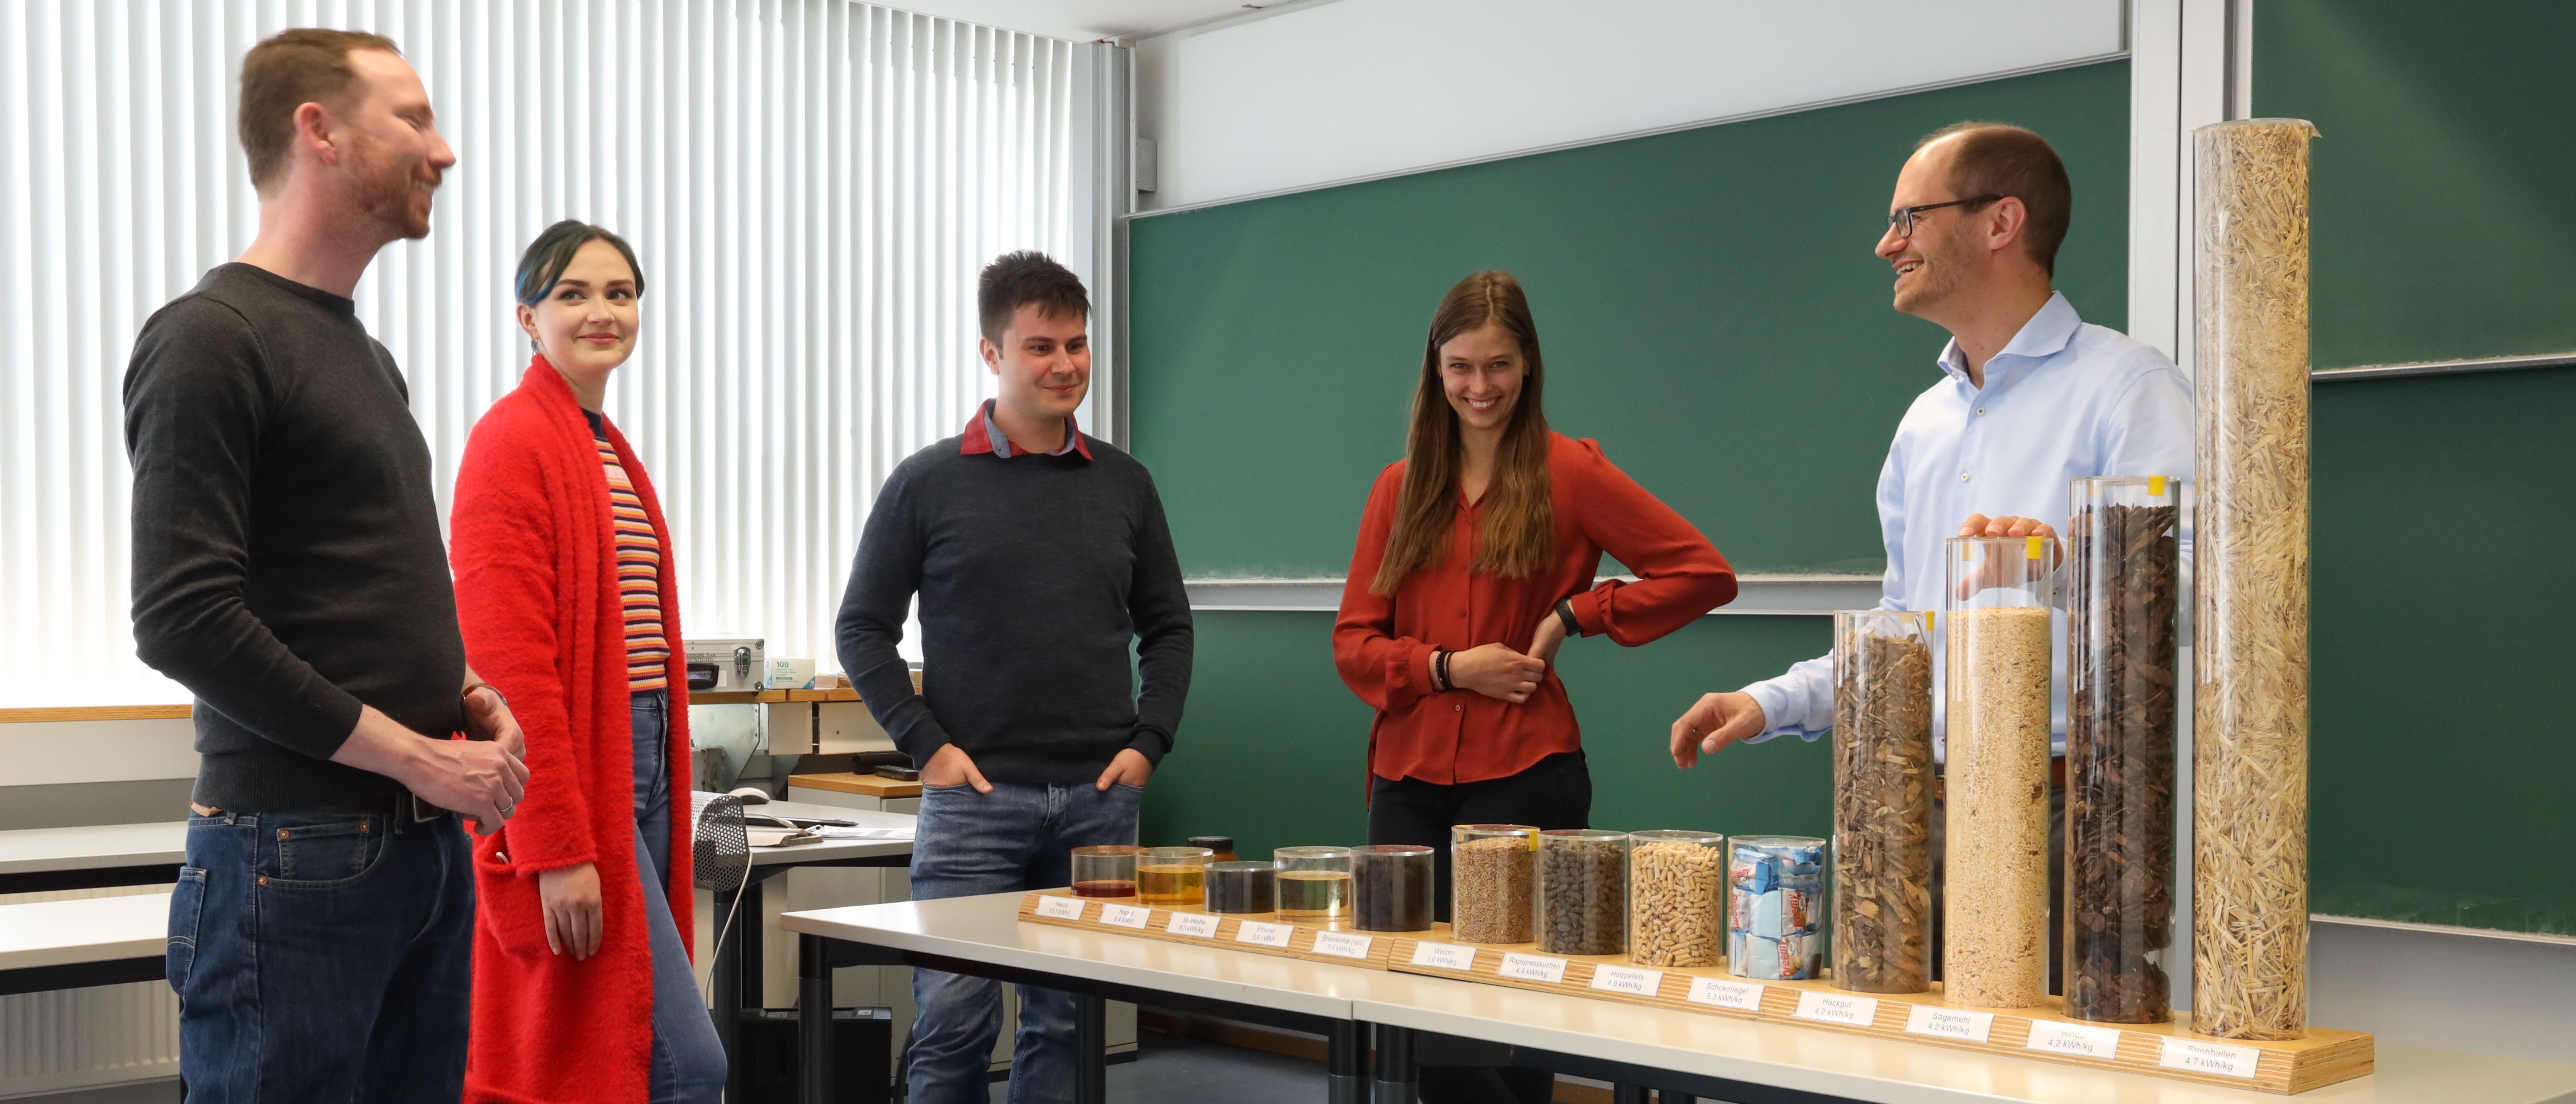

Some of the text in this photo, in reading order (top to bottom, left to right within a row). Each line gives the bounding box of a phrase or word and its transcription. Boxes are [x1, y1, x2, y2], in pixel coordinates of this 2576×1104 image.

[1731, 868, 1752, 878] reemy
[1733, 894, 1741, 930] Dreem
[1187, 926, 1204, 934] kWh/kg
[1322, 935, 1366, 947] Braunkohle (atro)
[1335, 946, 1354, 955] kWh/kg
[1435, 947, 1454, 956] Weizen
[1436, 957, 1457, 966] kWh/kg
[1509, 957, 1560, 969] Rapspresskuchen
[1526, 968, 1548, 978] kWh/kg
[1610, 970, 1644, 980] Holzpellets
[1618, 981, 1641, 991] kWh/kg
[1706, 982, 1749, 995] Schokoriegel
[1718, 994, 1743, 1005] kWh/kg
[1822, 998, 1851, 1008] Hackgut
[1827, 1009, 1854, 1020] kWh/kg
[1932, 1012, 1970, 1023] Sägemehl
[1928, 1022, 1969, 1036] 4,2 kWh/kg
[2048, 1039, 2093, 1053] 4,2 kWh/kg
[2188, 1046, 2236, 1059] Strohballen
[2185, 1057, 2233, 1072] 4,7 kWh/kg
